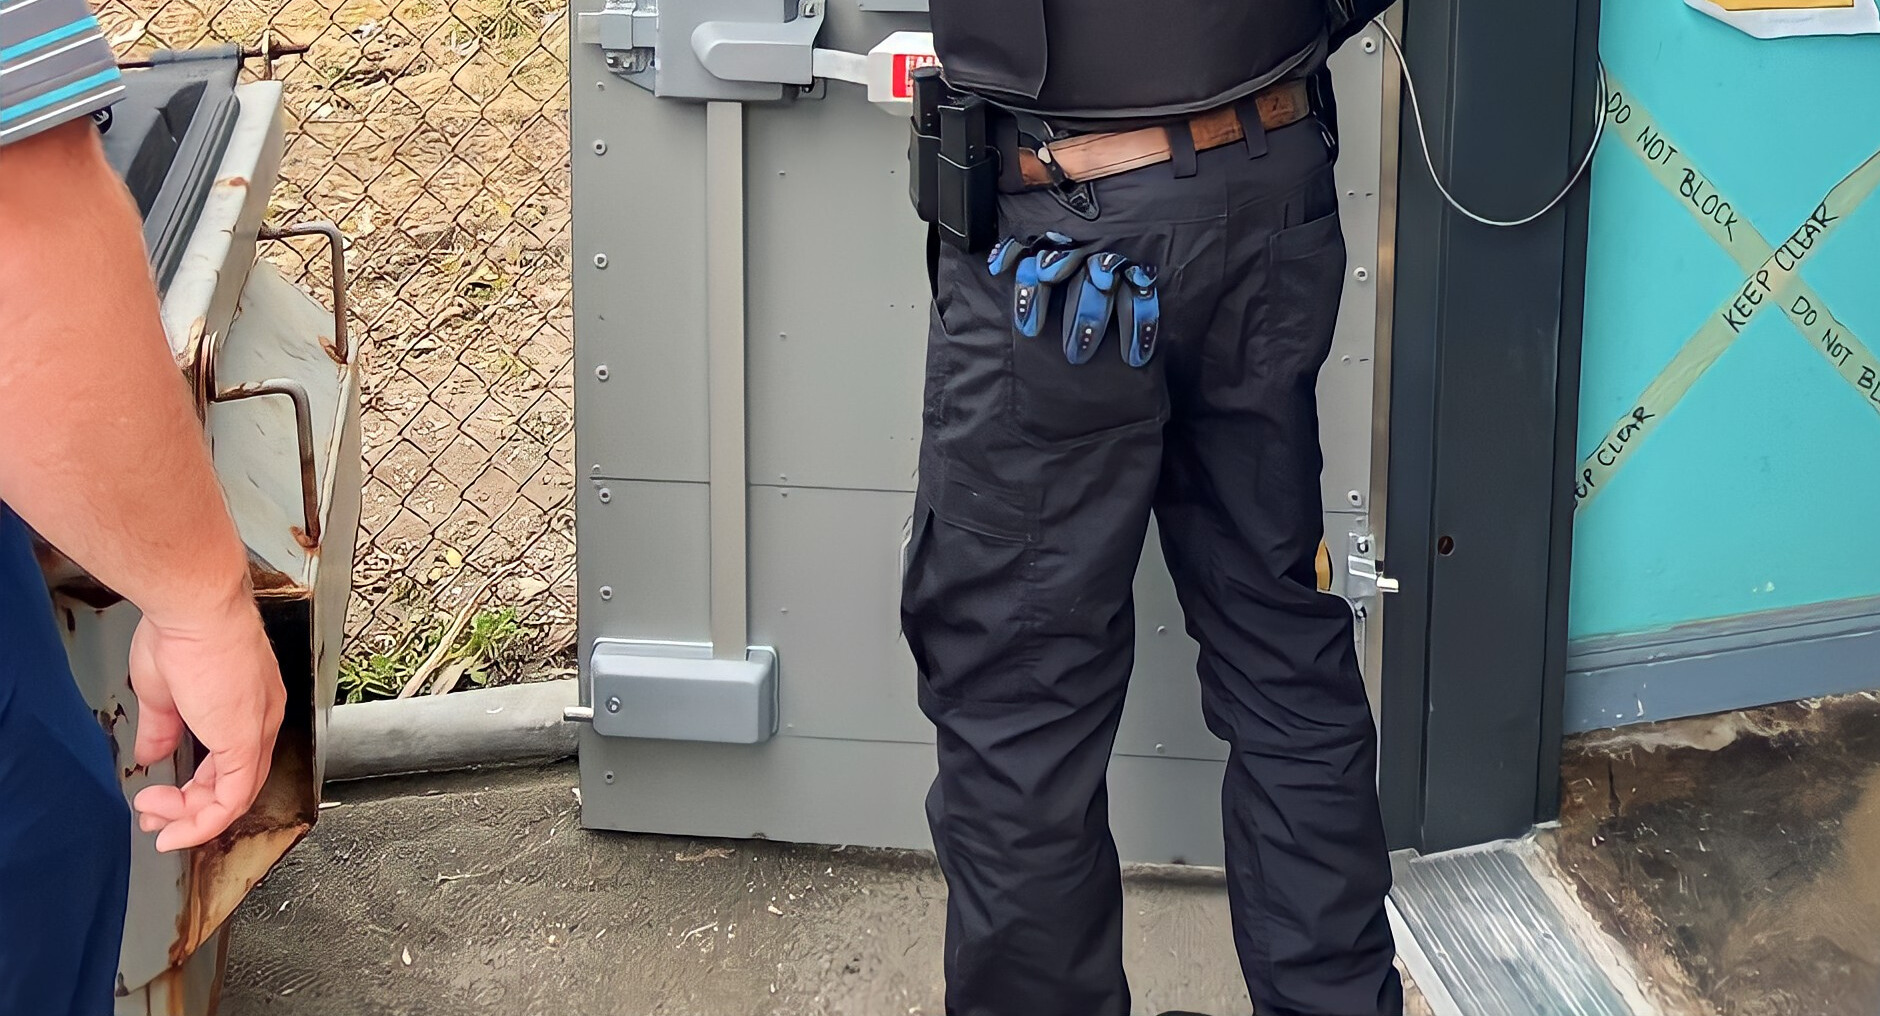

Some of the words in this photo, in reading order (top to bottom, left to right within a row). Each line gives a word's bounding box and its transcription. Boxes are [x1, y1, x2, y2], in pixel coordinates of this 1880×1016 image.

[1607, 92, 1631, 124] DO
[1636, 125, 1678, 165] NOT
[1679, 167, 1738, 243] BLOCK
[1722, 269, 1771, 333] KEEP
[1774, 202, 1839, 272] CLEAR
[1791, 295, 1818, 326] DO
[1822, 328, 1853, 367] NOT
[1597, 406, 1656, 466] CLEAR
